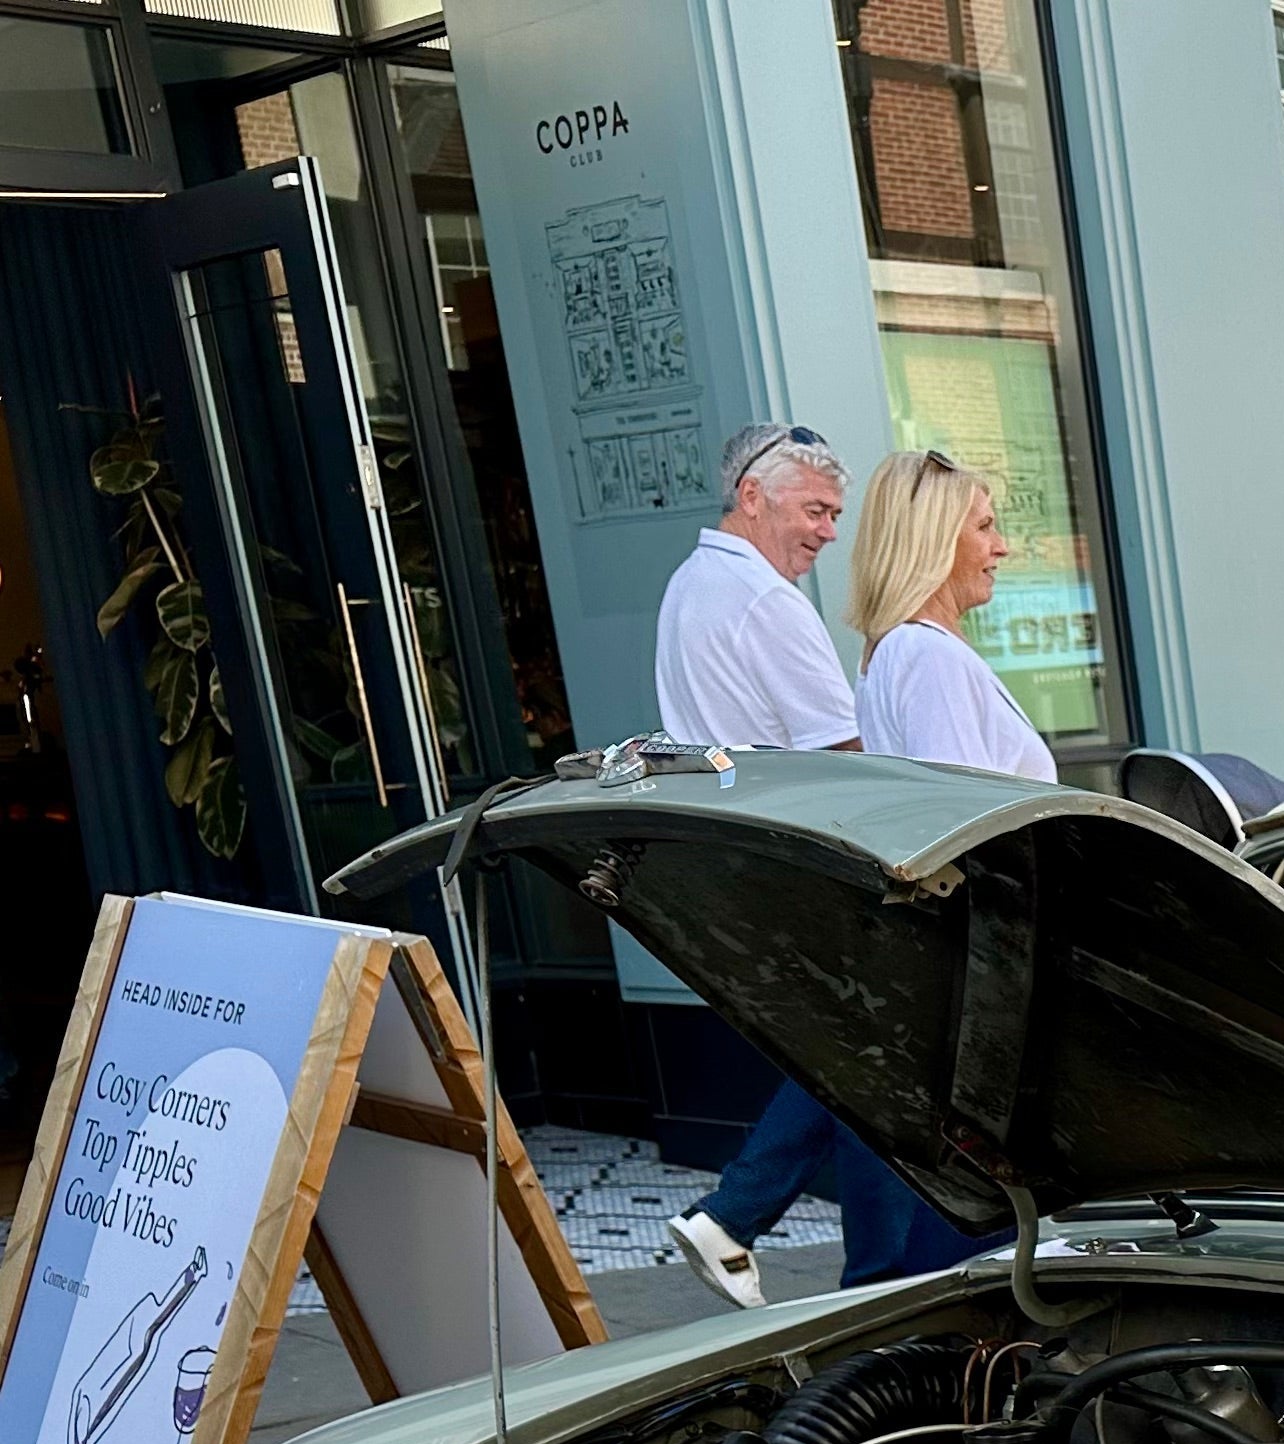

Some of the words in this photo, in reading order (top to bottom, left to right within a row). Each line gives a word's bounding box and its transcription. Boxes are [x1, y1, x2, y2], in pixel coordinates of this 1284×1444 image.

[536, 99, 630, 155] COPPA
[570, 150, 604, 169] CLUB
[411, 586, 442, 609] TS
[121, 979, 163, 1007] HEAD
[163, 989, 212, 1019] INSIDE
[213, 999, 247, 1025] FOR
[96, 1061, 147, 1117] Cosy
[148, 1074, 231, 1131] Corners
[81, 1117, 118, 1173] Top
[122, 1128, 198, 1188] Tipples
[64, 1177, 122, 1229] Good
[122, 1192, 178, 1248] Vibes
[42, 1265, 67, 1292] Come
[67, 1278, 79, 1295] on
